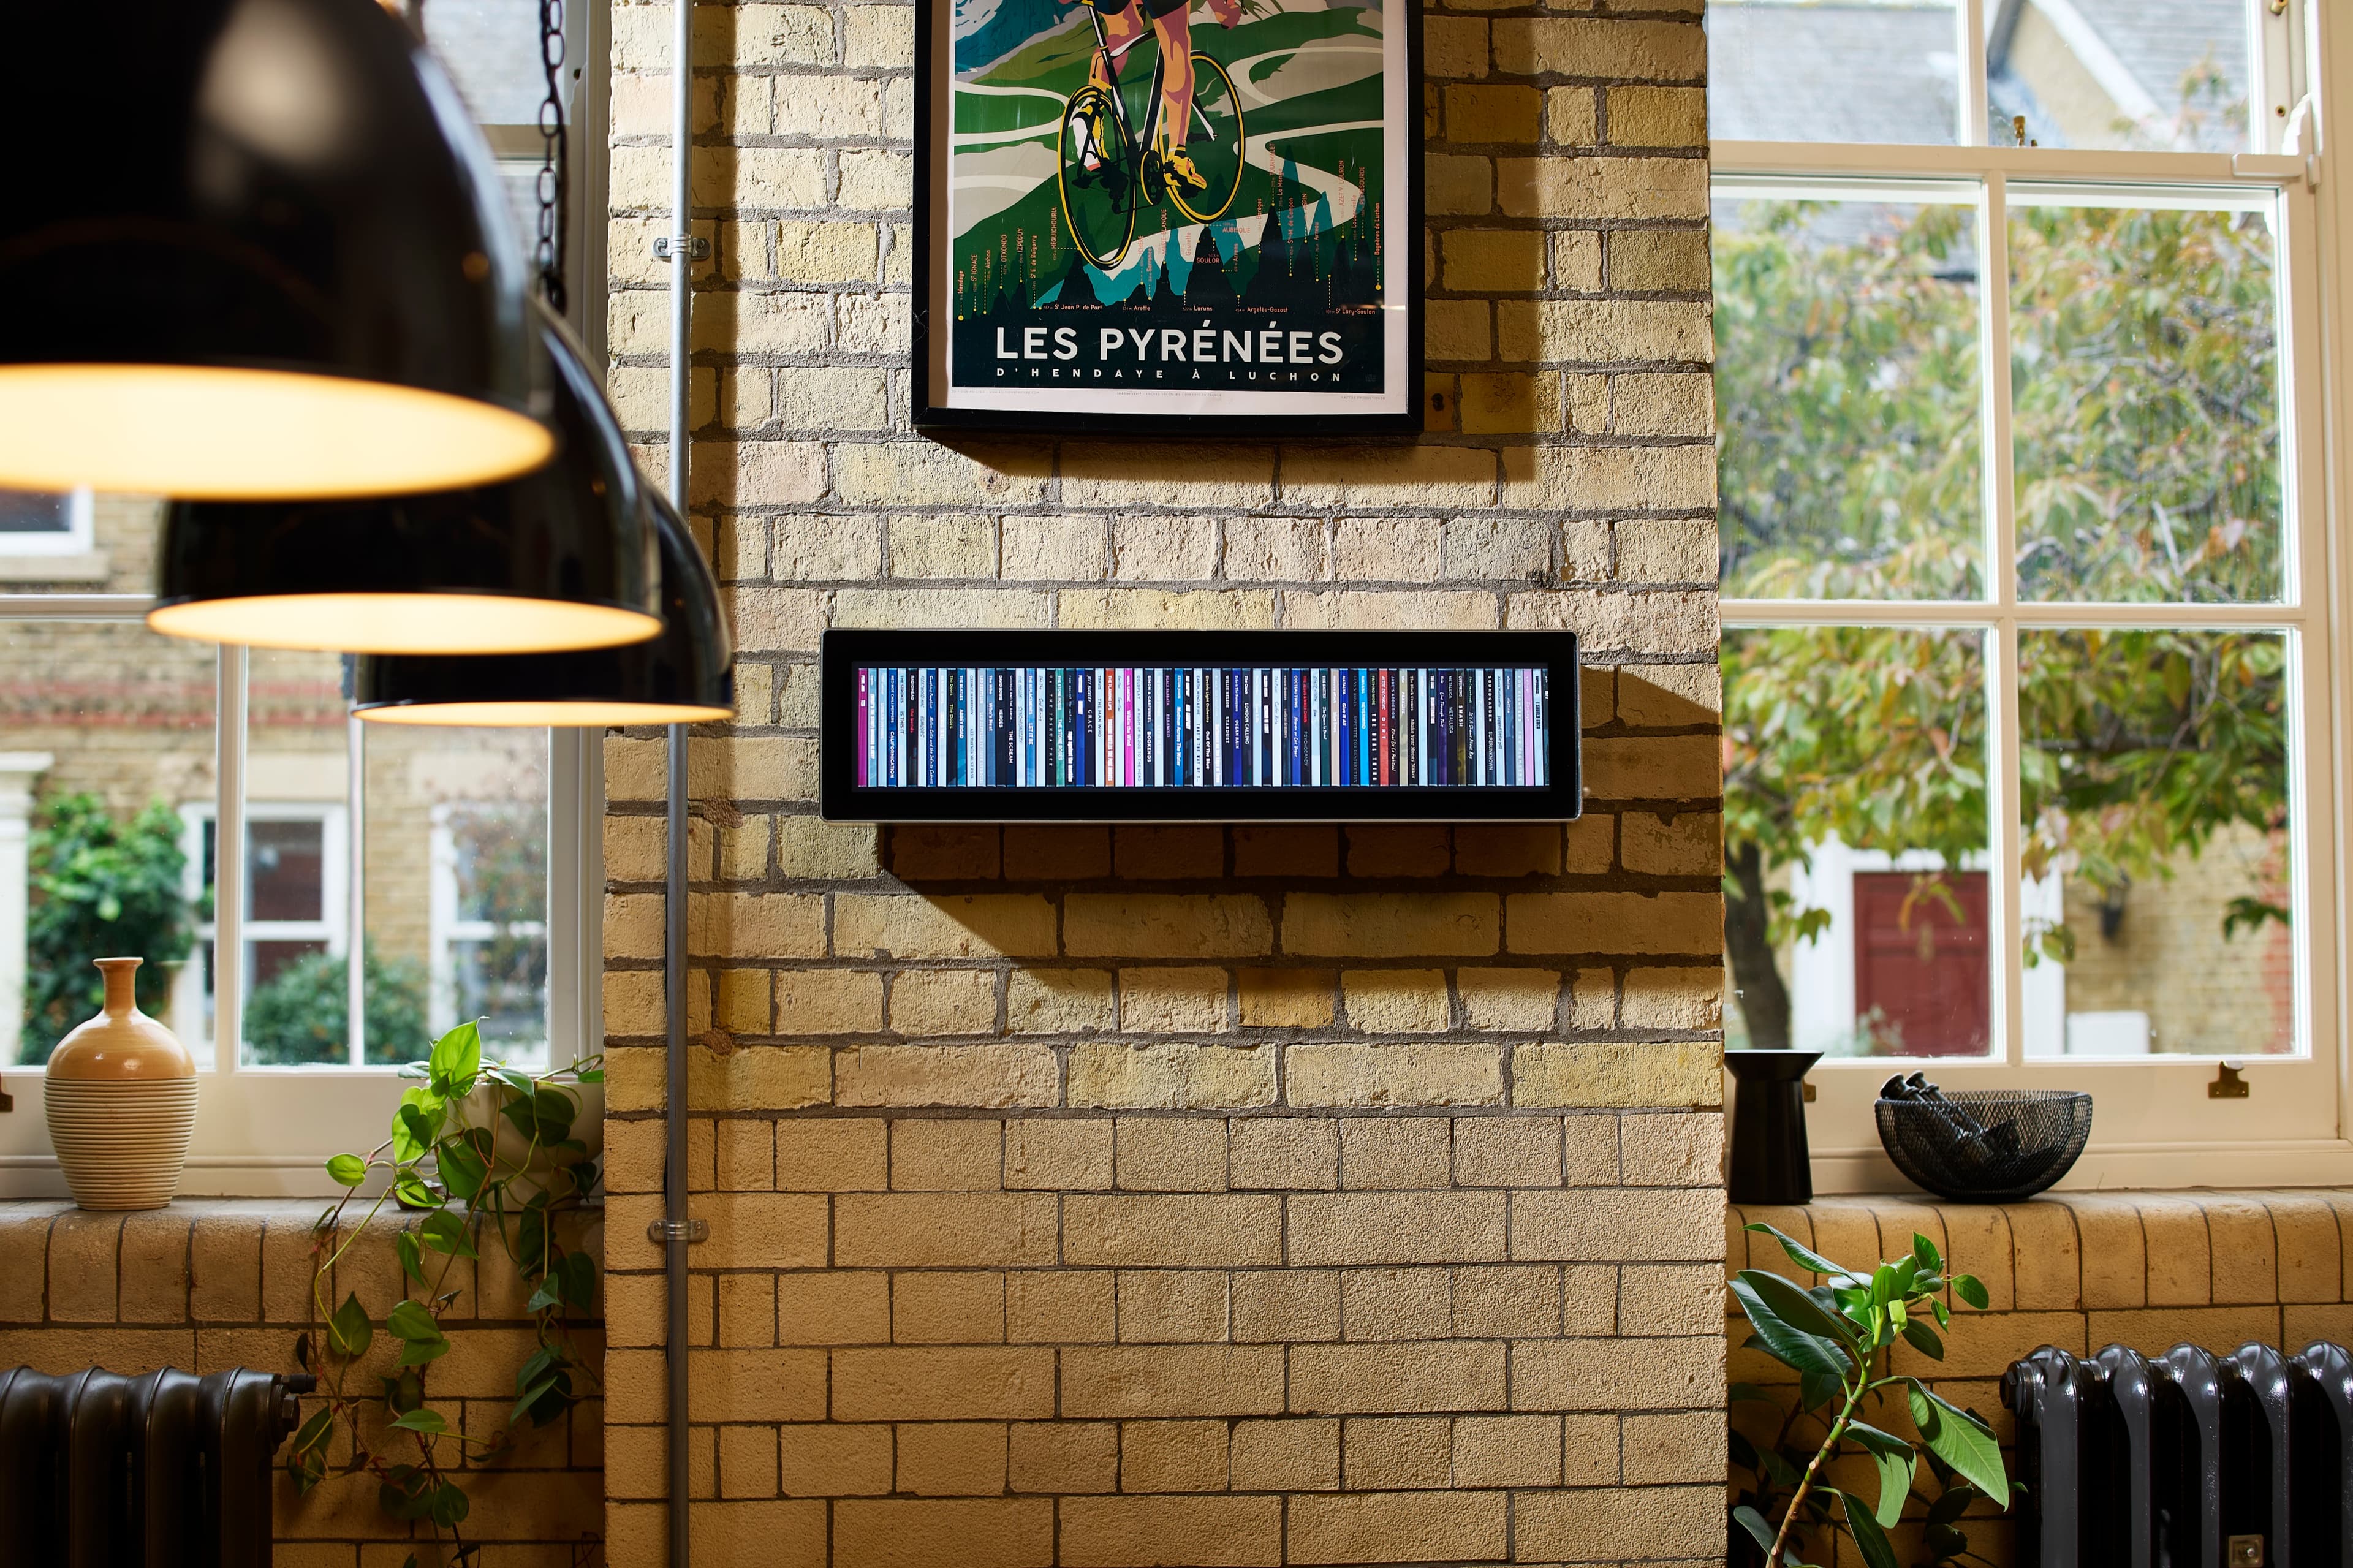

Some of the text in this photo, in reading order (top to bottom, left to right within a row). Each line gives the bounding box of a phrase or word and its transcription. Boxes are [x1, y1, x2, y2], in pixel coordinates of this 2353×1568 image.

[997, 320, 1343, 364] LES PYRÉNÉES
[997, 368, 1340, 381] D'HENDAYE À LUCHON
